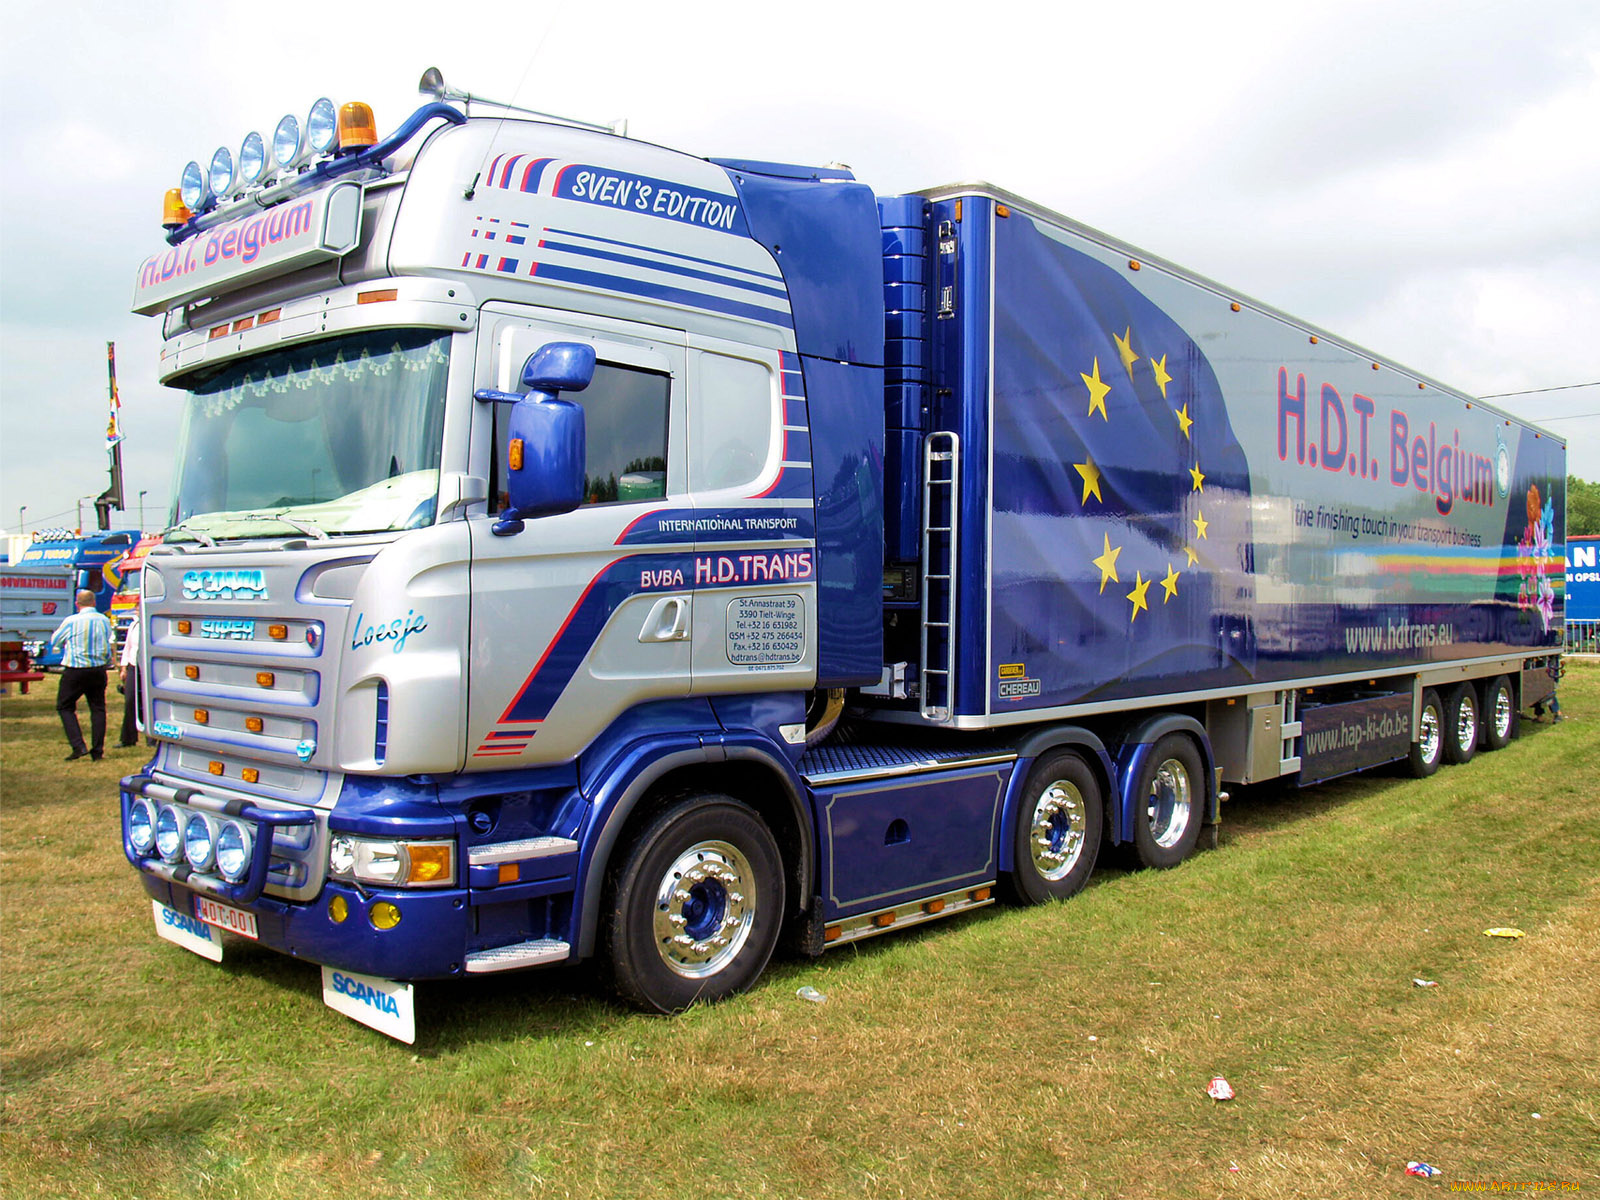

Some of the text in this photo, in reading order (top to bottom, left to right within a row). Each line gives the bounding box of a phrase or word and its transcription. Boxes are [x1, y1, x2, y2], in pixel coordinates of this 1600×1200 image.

[572, 171, 737, 230] SVEN'S EDITION
[204, 200, 313, 264] Belgium
[1278, 366, 1494, 516] H.D.T. Belgium
[658, 518, 798, 532] INTERNATIONAAL TRANSPORT
[1295, 503, 1482, 548] the finishing touch in your transport business
[182, 570, 269, 600] SCANIA
[640, 569, 685, 588] BVBA
[739, 610, 796, 620] 3390 Tielt-Winge
[787, 600, 796, 608] 39
[352, 609, 428, 655] Loesje
[729, 632, 745, 640] GSM
[746, 632, 760, 640] +32
[762, 632, 775, 640] 475
[762, 621, 770, 629] 16
[1346, 617, 1453, 653] www.hdtrans.eu
[731, 652, 800, 662] hdtrans@hdtrans.be
[762, 642, 770, 650] 16
[1000, 682, 1039, 695] CHEREAU
[1306, 712, 1408, 755] www.hap-ki-do.be
[162, 908, 212, 942] SCANIA
[332, 971, 400, 1019] SCANIA
